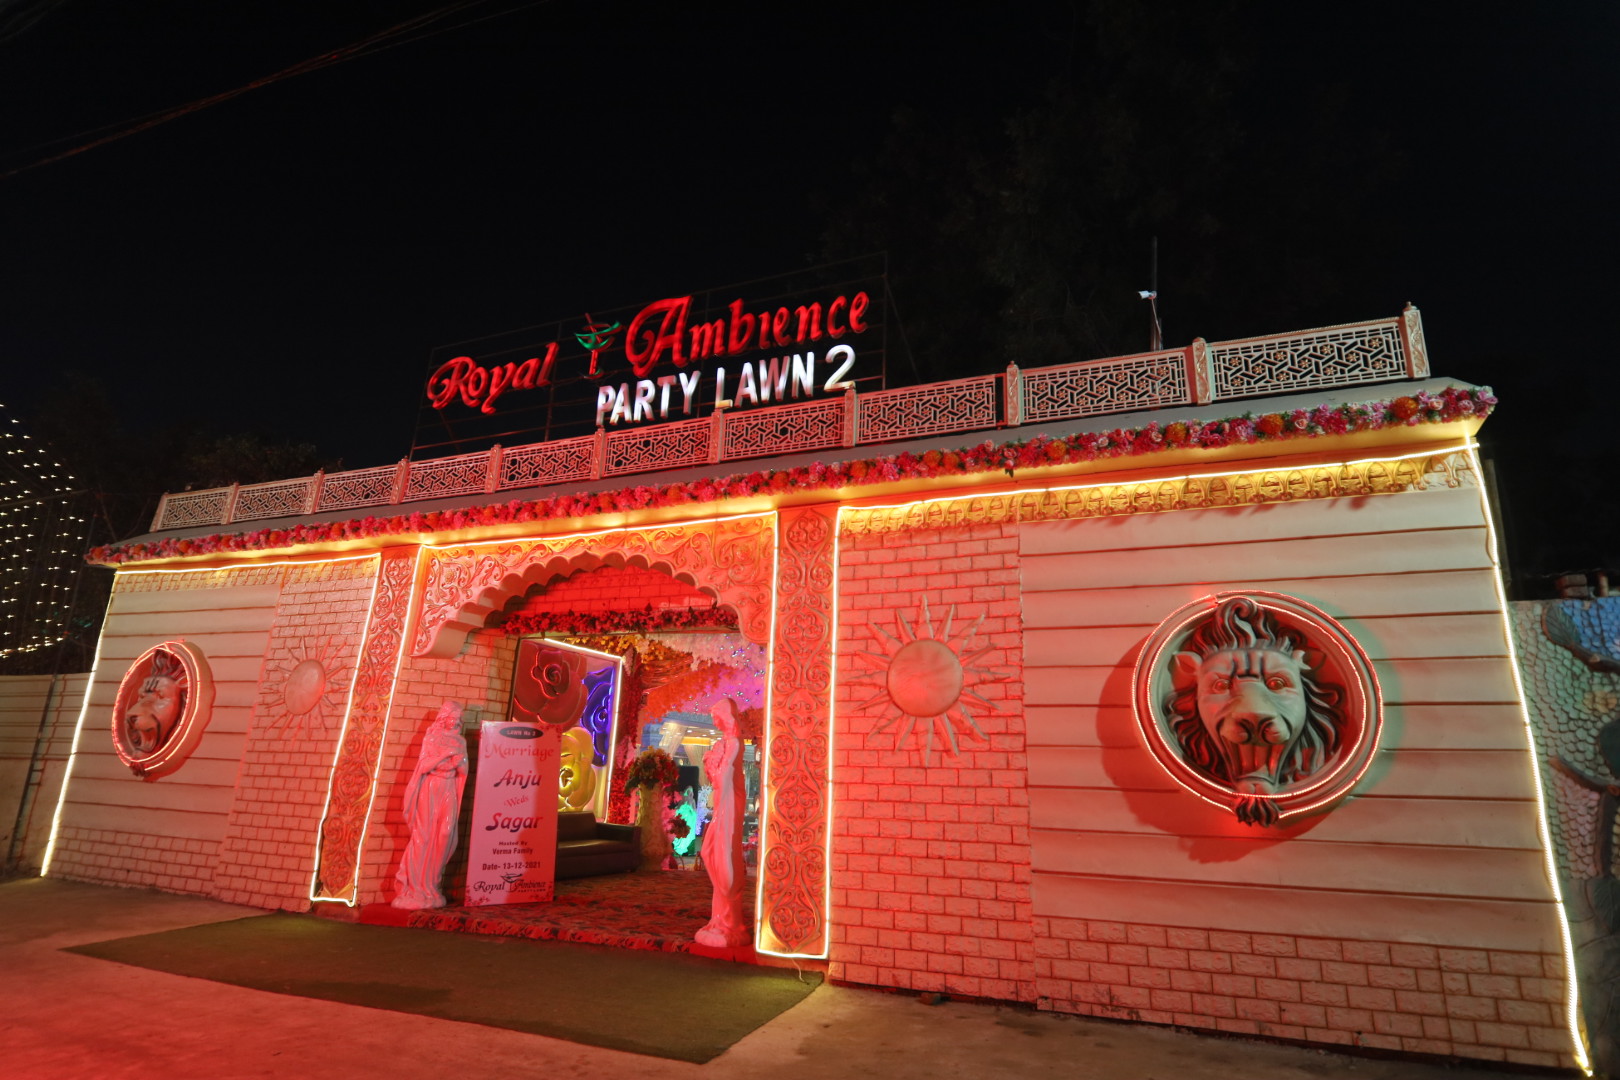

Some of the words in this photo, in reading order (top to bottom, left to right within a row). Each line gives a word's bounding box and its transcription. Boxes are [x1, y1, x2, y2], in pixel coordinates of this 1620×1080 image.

[427, 342, 559, 414] Royal
[625, 291, 869, 377] Ambience
[596, 370, 701, 426] PARTY
[714, 351, 814, 409] LAWN
[823, 344, 856, 392] 2
[485, 744, 554, 760] Marriage
[493, 769, 542, 789] Anju
[504, 795, 529, 807] Weds
[485, 812, 543, 833] Sagar
[513, 847, 533, 855] Family
[503, 861, 540, 870] 13-12-2021
[473, 881, 506, 894] Royal
